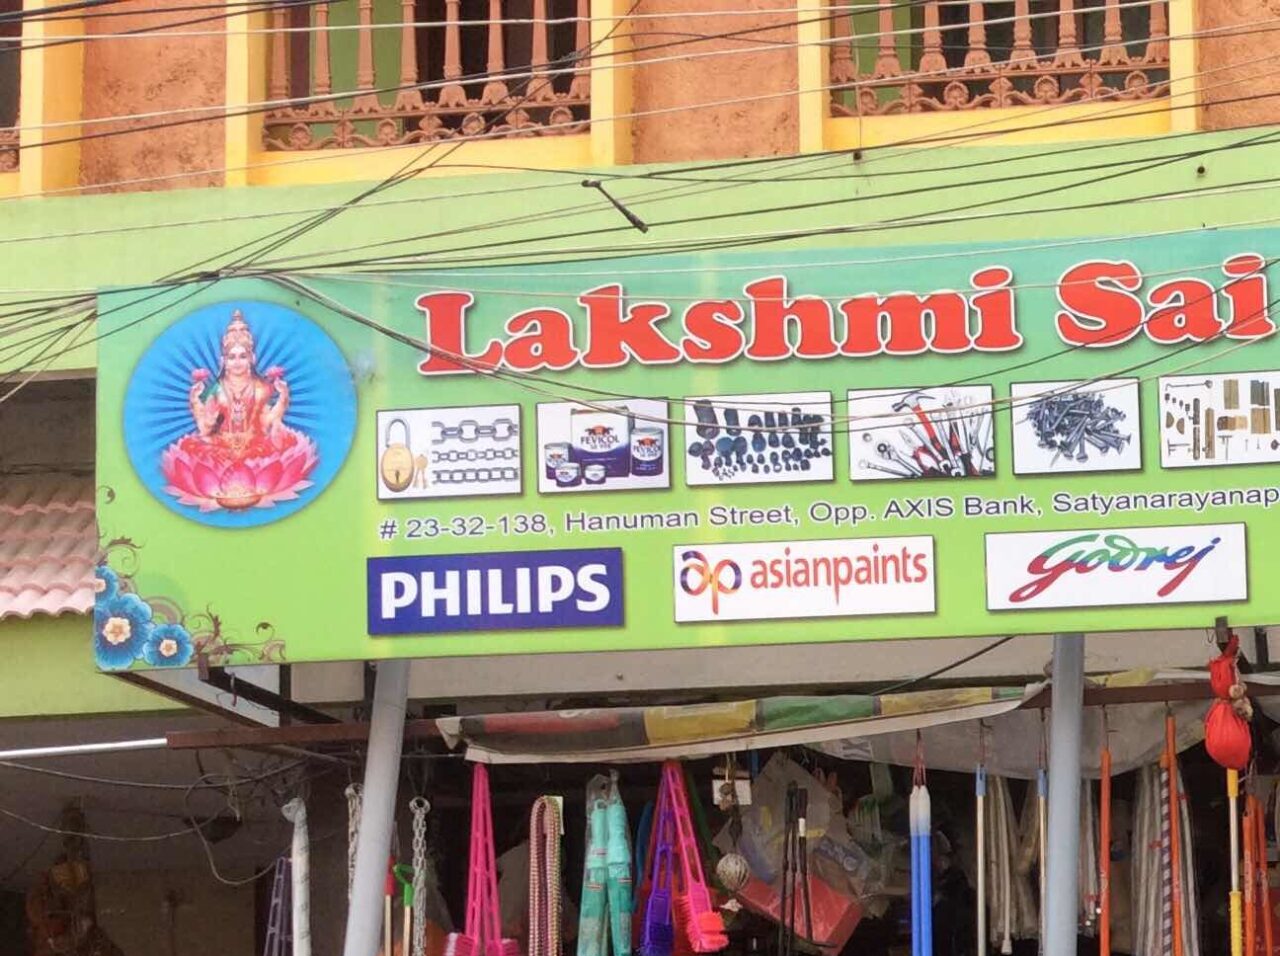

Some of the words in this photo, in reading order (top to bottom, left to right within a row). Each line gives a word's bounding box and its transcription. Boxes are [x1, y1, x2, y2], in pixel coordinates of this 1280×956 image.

[415, 267, 1022, 376] Lakshmi
[1055, 253, 1276, 348] Sai
[406, 514, 555, 538] 23-32-138,
[565, 507, 699, 532] Hanuman
[709, 503, 800, 527] Street,
[809, 501, 876, 526] Opp.
[884, 497, 954, 519] AXIS
[964, 495, 1044, 517] Bank,
[380, 564, 611, 619] PHILIPS
[750, 543, 929, 606] asianpaints
[1008, 533, 1222, 603] Godrej
